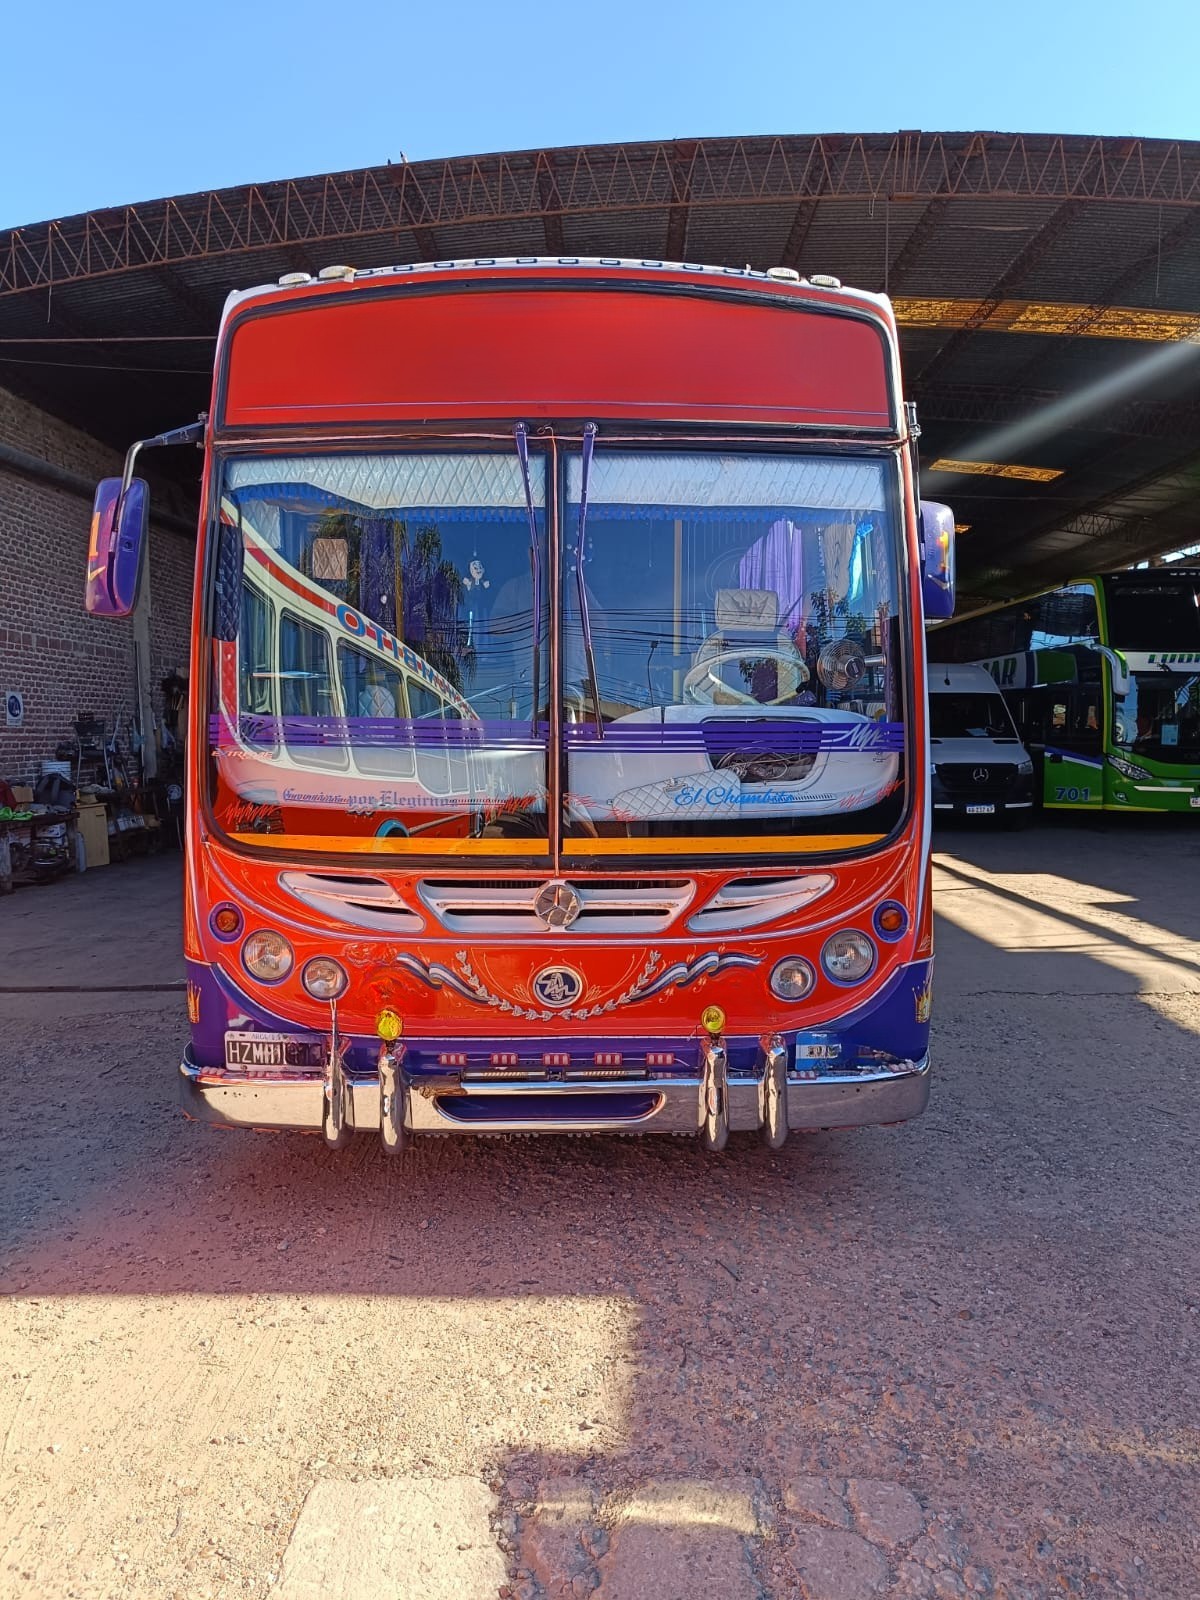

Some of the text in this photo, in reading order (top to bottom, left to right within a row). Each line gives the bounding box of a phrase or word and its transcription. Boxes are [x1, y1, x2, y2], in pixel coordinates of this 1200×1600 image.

[348, 794, 376, 807] por
[674, 786, 794, 806] El Chambito
[1055, 787, 1091, 801] 701
